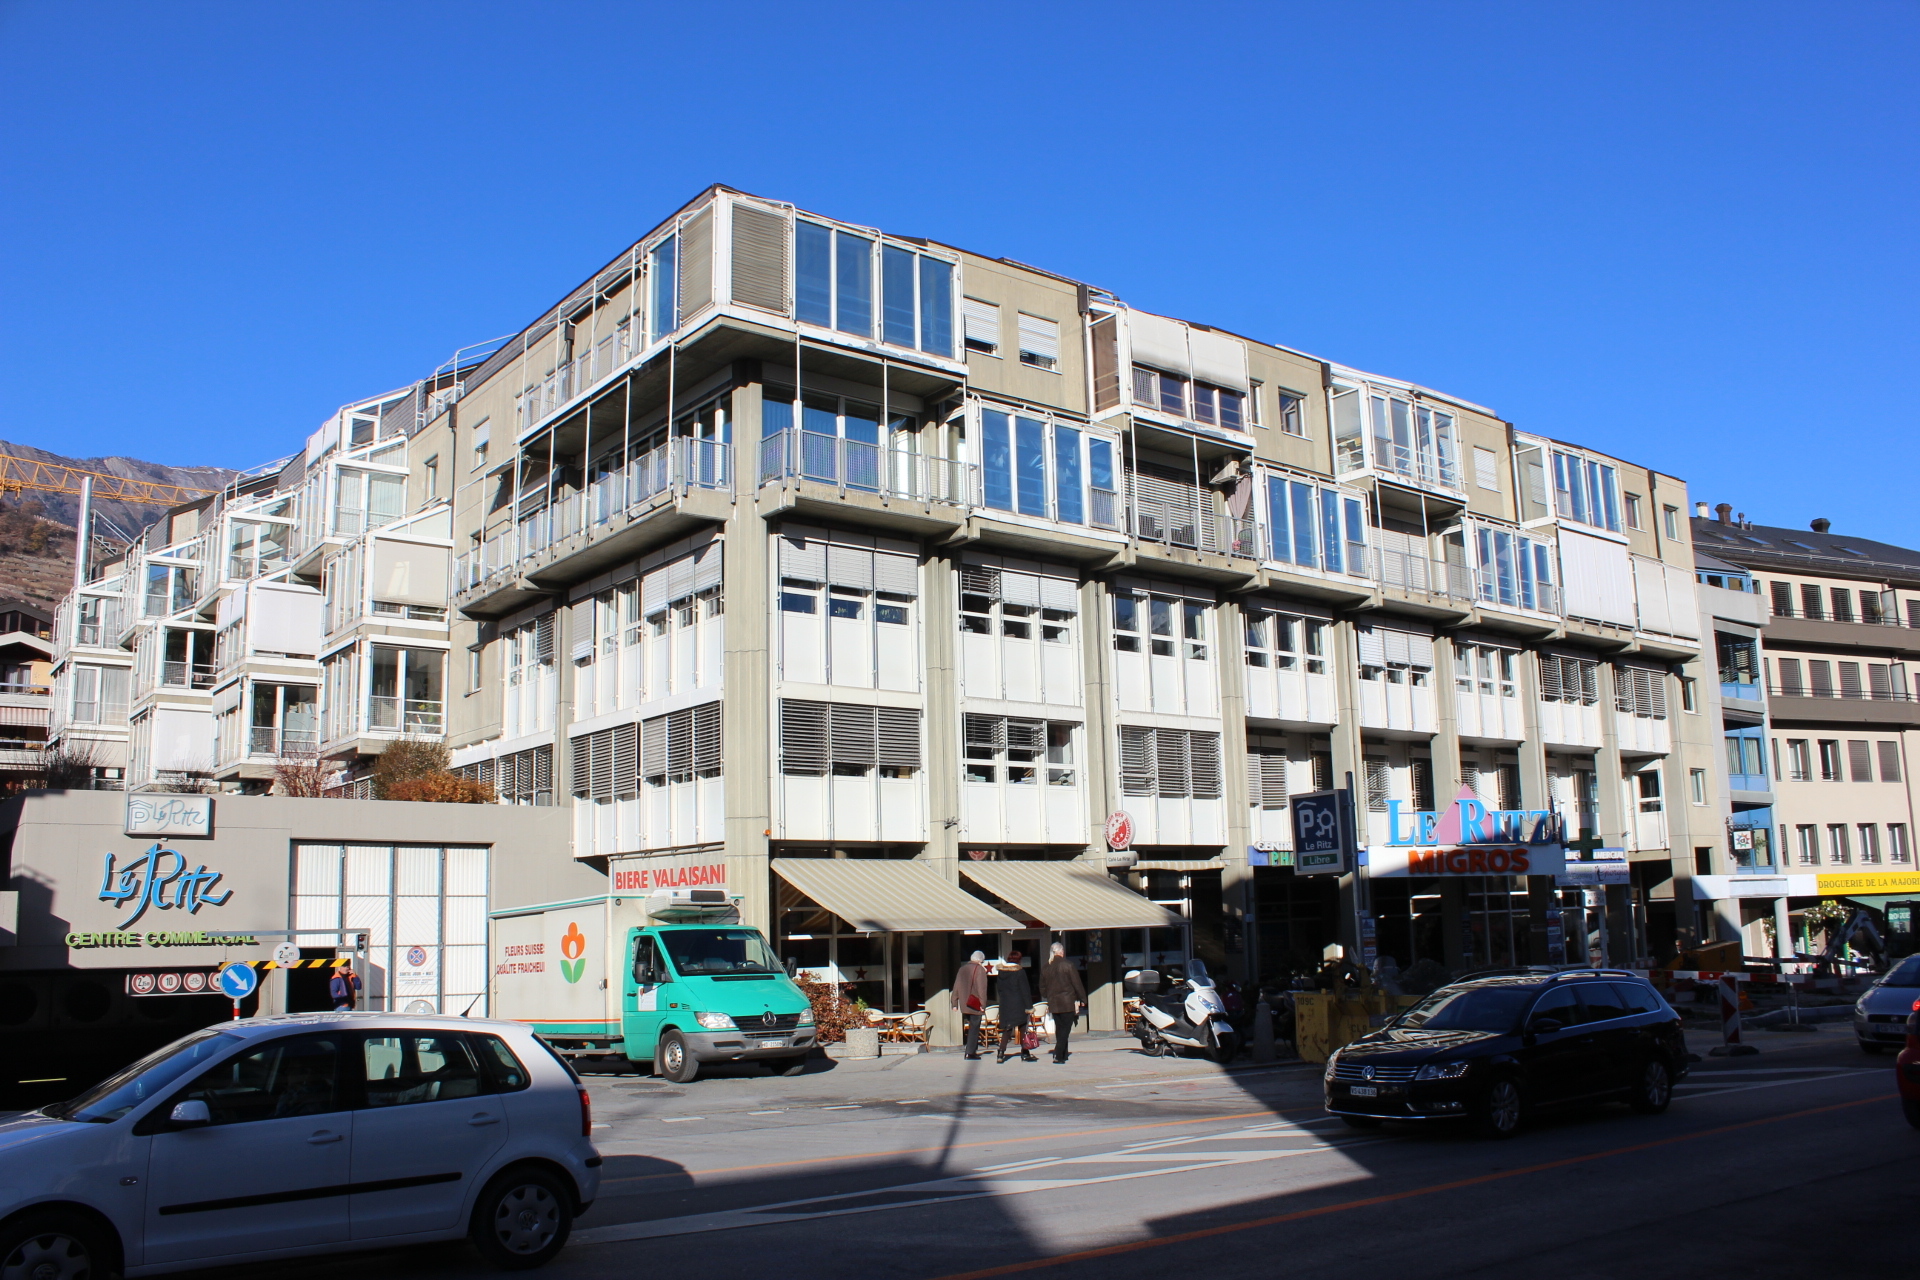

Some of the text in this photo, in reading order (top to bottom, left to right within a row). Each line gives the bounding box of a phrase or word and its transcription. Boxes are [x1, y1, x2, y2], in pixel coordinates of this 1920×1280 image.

[1384, 798, 1554, 846] LE RITZ
[1305, 840, 1332, 850] Le Ritz
[1309, 856, 1331, 865] Libre
[1408, 848, 1530, 875] MIGROS
[98, 842, 231, 929] Le Ritz
[615, 870, 648, 890] BIERE
[1818, 879, 1864, 889] DROGUERIE
[1866, 878, 1877, 887] DE
[1878, 878, 1888, 887] LA
[65, 931, 138, 947] CENTRE
[505, 945, 524, 957] FLEURS
[166, 976, 173, 986] 10
